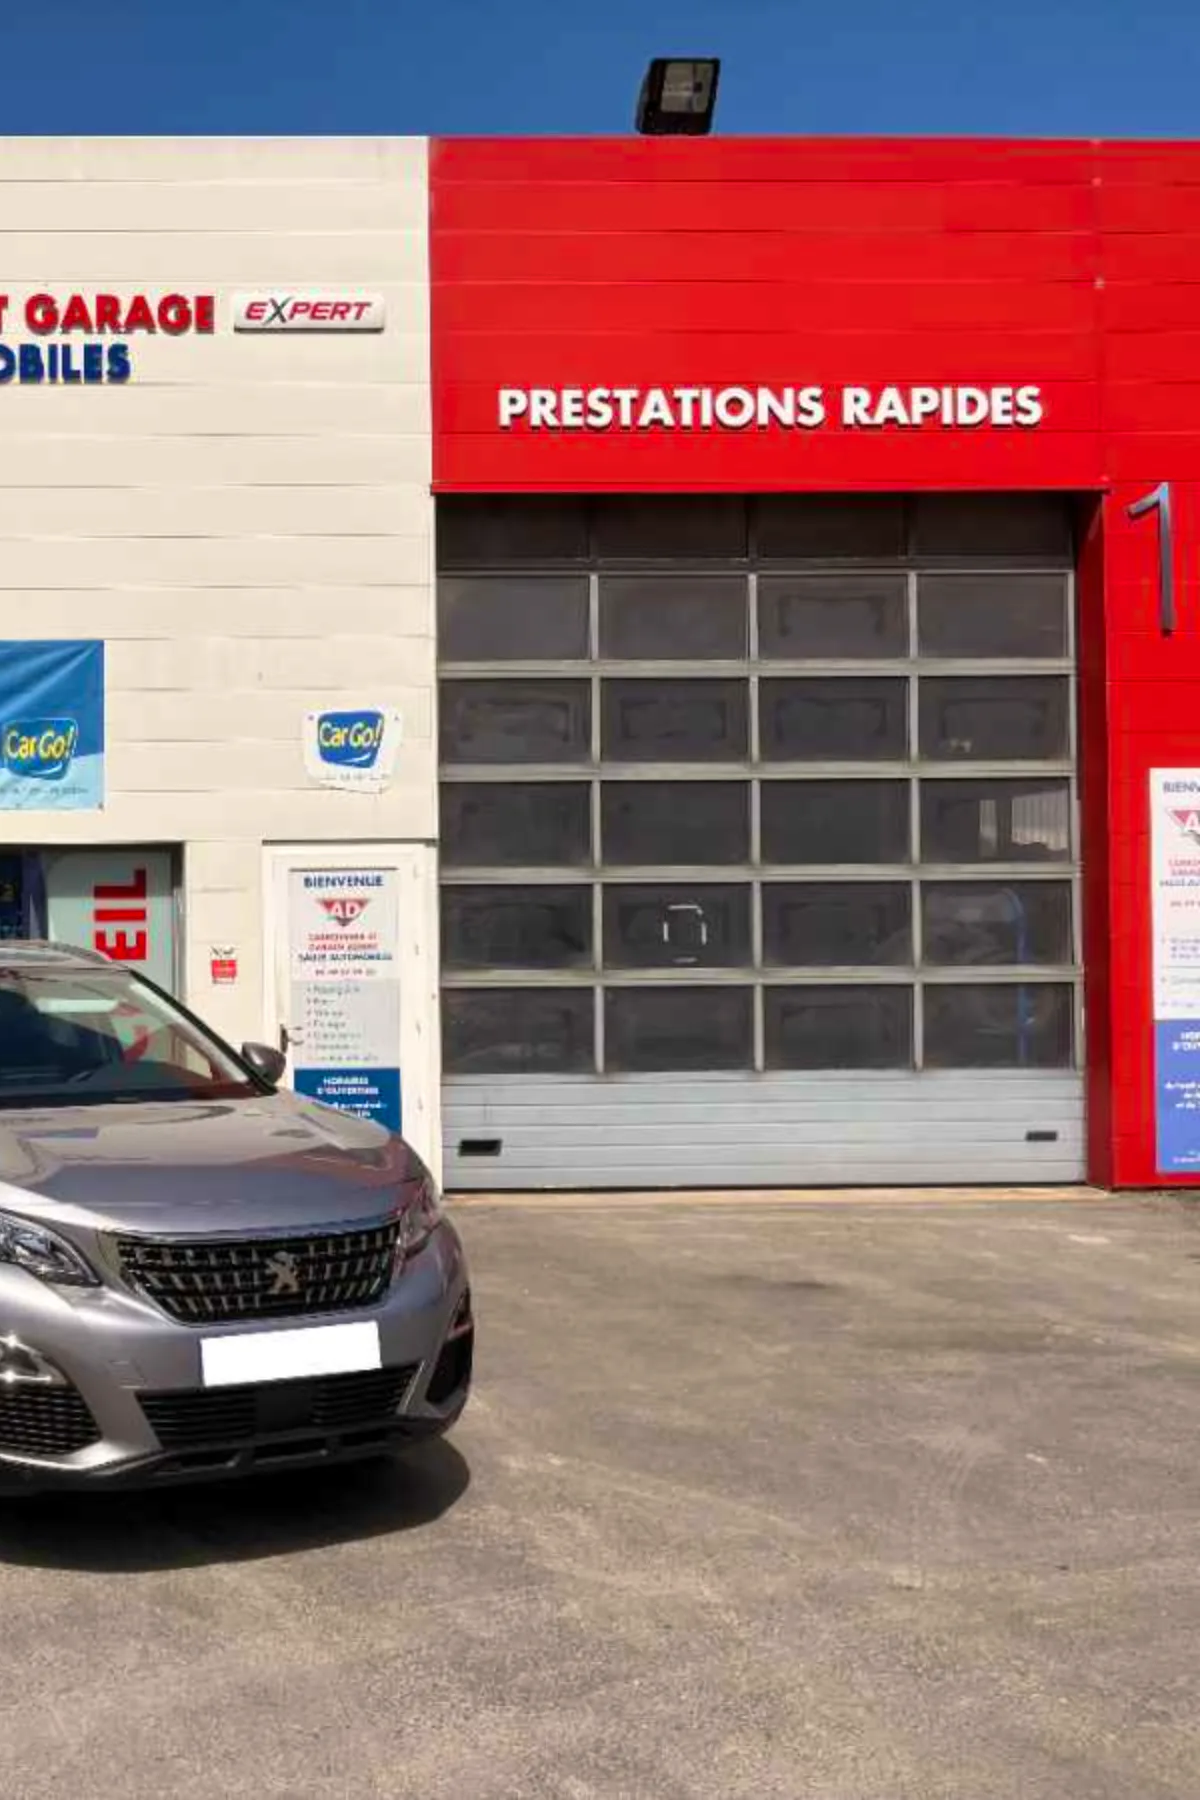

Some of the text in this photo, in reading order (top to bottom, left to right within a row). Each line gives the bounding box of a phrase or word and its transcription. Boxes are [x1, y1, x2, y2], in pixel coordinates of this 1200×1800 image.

[25, 294, 214, 335] GARAGE
[245, 297, 372, 325] EXPERT
[499, 386, 1043, 429] PRESTATIONS RAPIDES
[304, 875, 384, 888] BIENVENUE
[331, 901, 360, 918] AD
